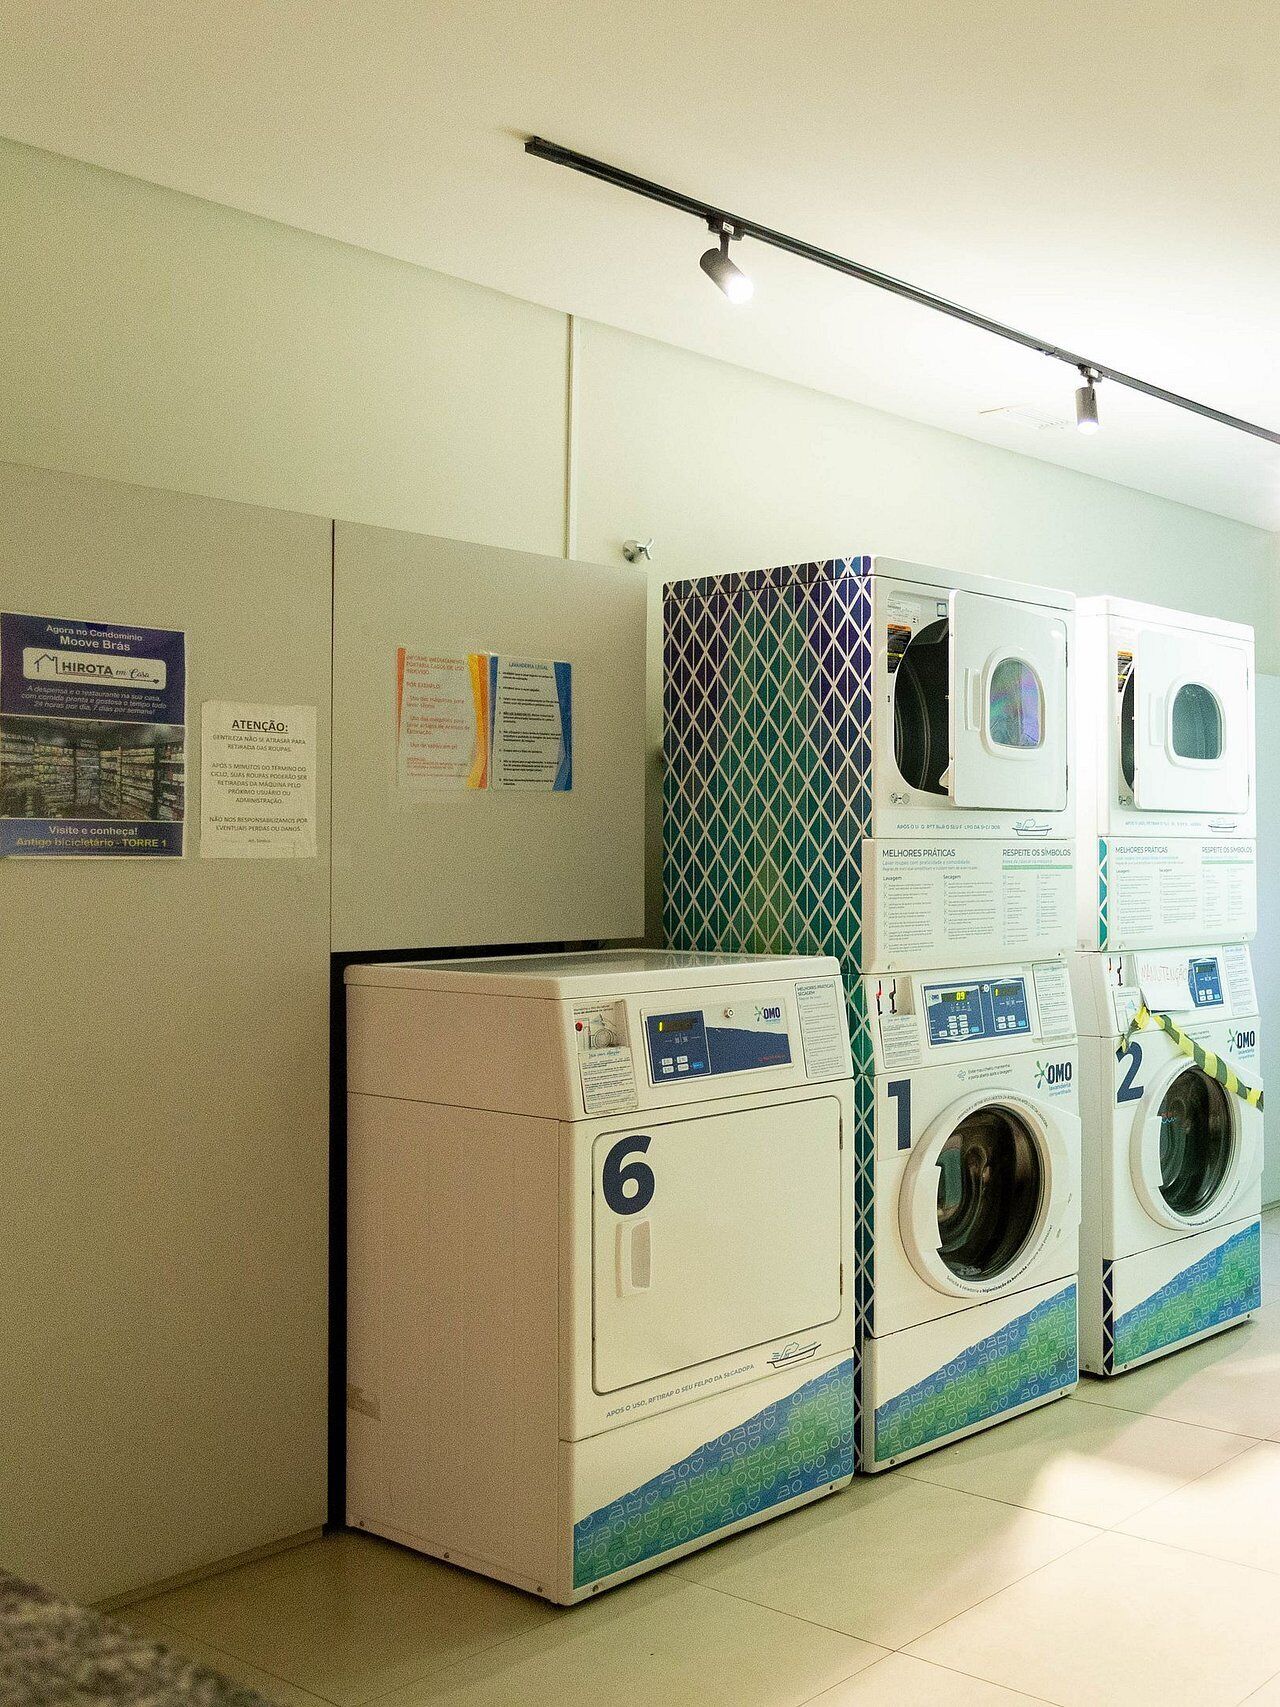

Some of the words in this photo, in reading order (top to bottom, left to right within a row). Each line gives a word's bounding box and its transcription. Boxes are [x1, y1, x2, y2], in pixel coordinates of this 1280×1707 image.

[46, 624, 74, 635] Agora
[76, 628, 87, 636] no
[60, 635, 100, 649] Moove
[102, 639, 131, 651] Brás
[62, 661, 113, 675] HIROTA
[232, 720, 288, 732] ATENÇÃO:
[49, 826, 79, 835] Visite
[90, 827, 139, 836] conheça!
[16, 838, 52, 848] Antigo
[54, 838, 114, 847] bicicletário
[122, 838, 158, 847] TORRE
[882, 849, 922, 857] MELHORES
[922, 847, 956, 857] PRÁTICAS
[1002, 849, 1030, 857] RESPEITE
[1041, 847, 1071, 857] SÍMBOLOS
[956, 991, 965, 1001] 09
[763, 1007, 781, 1019] OMO
[1236, 1030, 1255, 1048] OMO
[1047, 1061, 1072, 1084] OMO
[1115, 1041, 1144, 1103] 2
[888, 1079, 911, 1151] 1
[602, 1135, 655, 1215] 6
